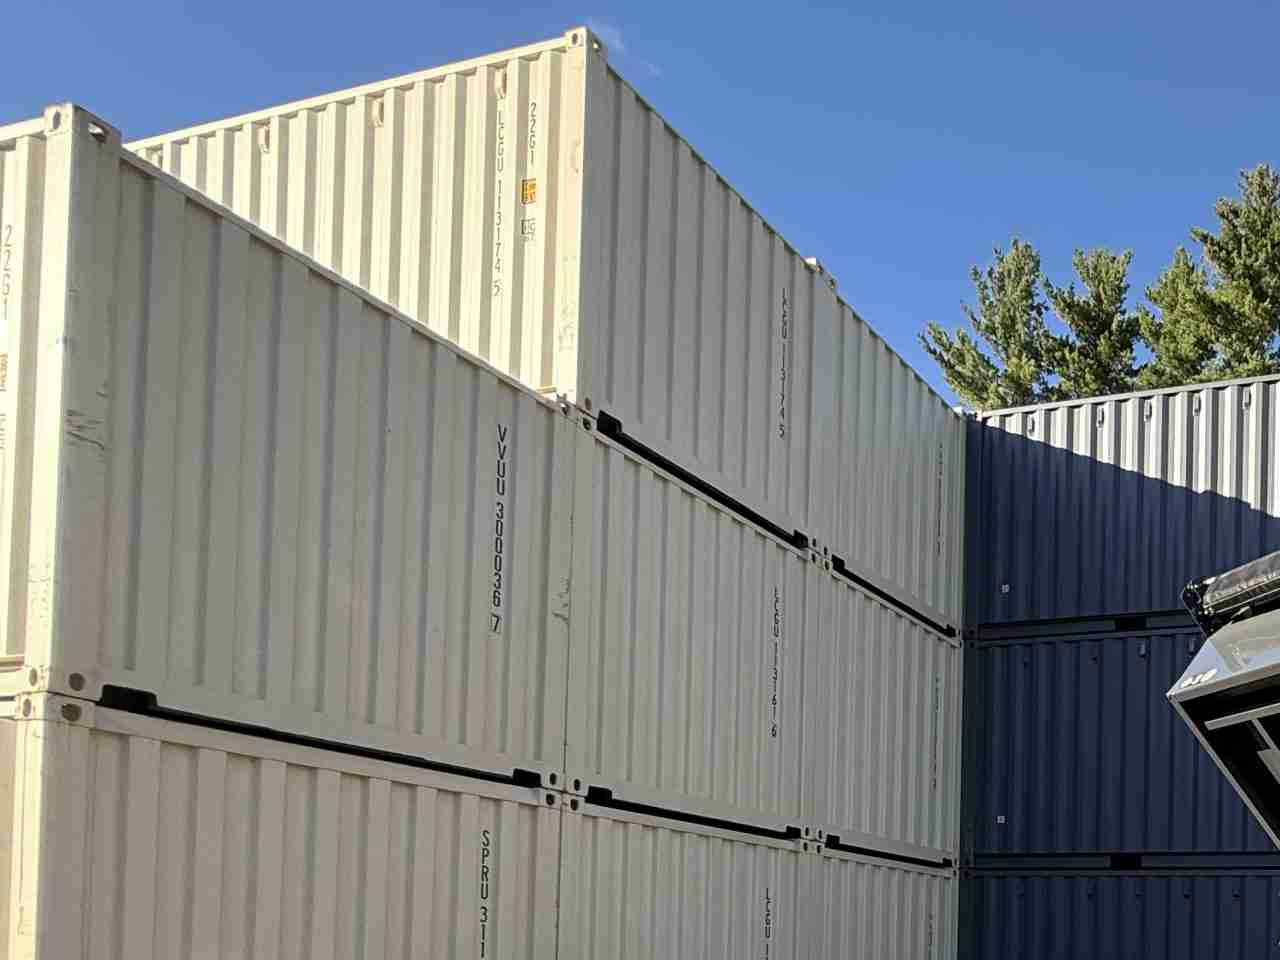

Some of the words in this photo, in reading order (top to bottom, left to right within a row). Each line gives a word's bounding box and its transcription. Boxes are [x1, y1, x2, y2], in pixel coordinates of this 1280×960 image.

[527, 101, 538, 166] 22G1
[496, 423, 508, 496] VVUU
[493, 501, 504, 608] 300036
[481, 829, 491, 900] SPRU
